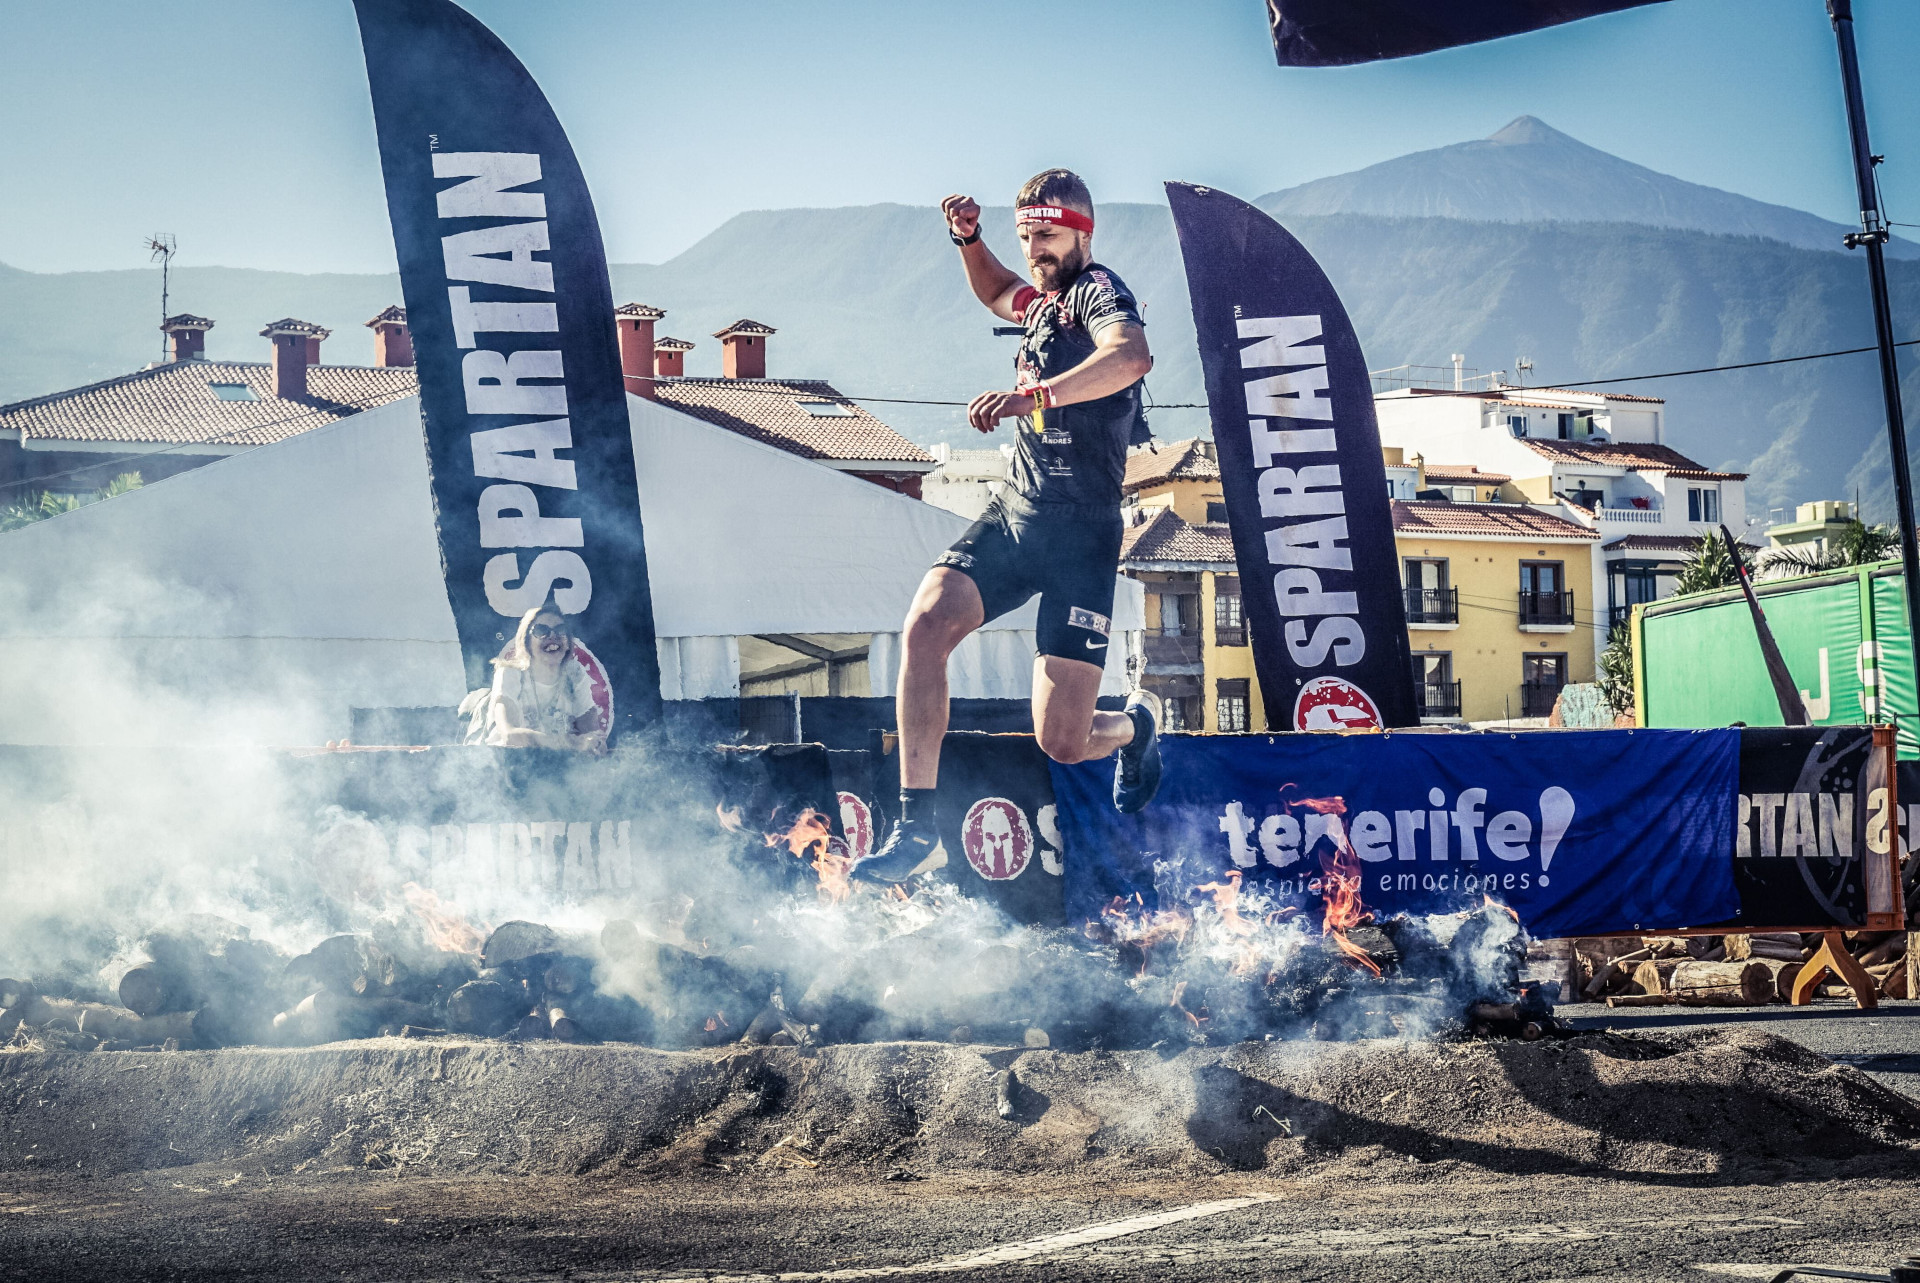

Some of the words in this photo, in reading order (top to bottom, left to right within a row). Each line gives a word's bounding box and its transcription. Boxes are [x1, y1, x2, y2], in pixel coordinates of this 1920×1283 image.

[432, 152, 592, 618] SPARTAN
[1236, 315, 1367, 667] SPARTAN
[397, 820, 633, 890] SPARTAN
[1218, 786, 1576, 888] tenerife!
[1380, 868, 1530, 894] emociones
